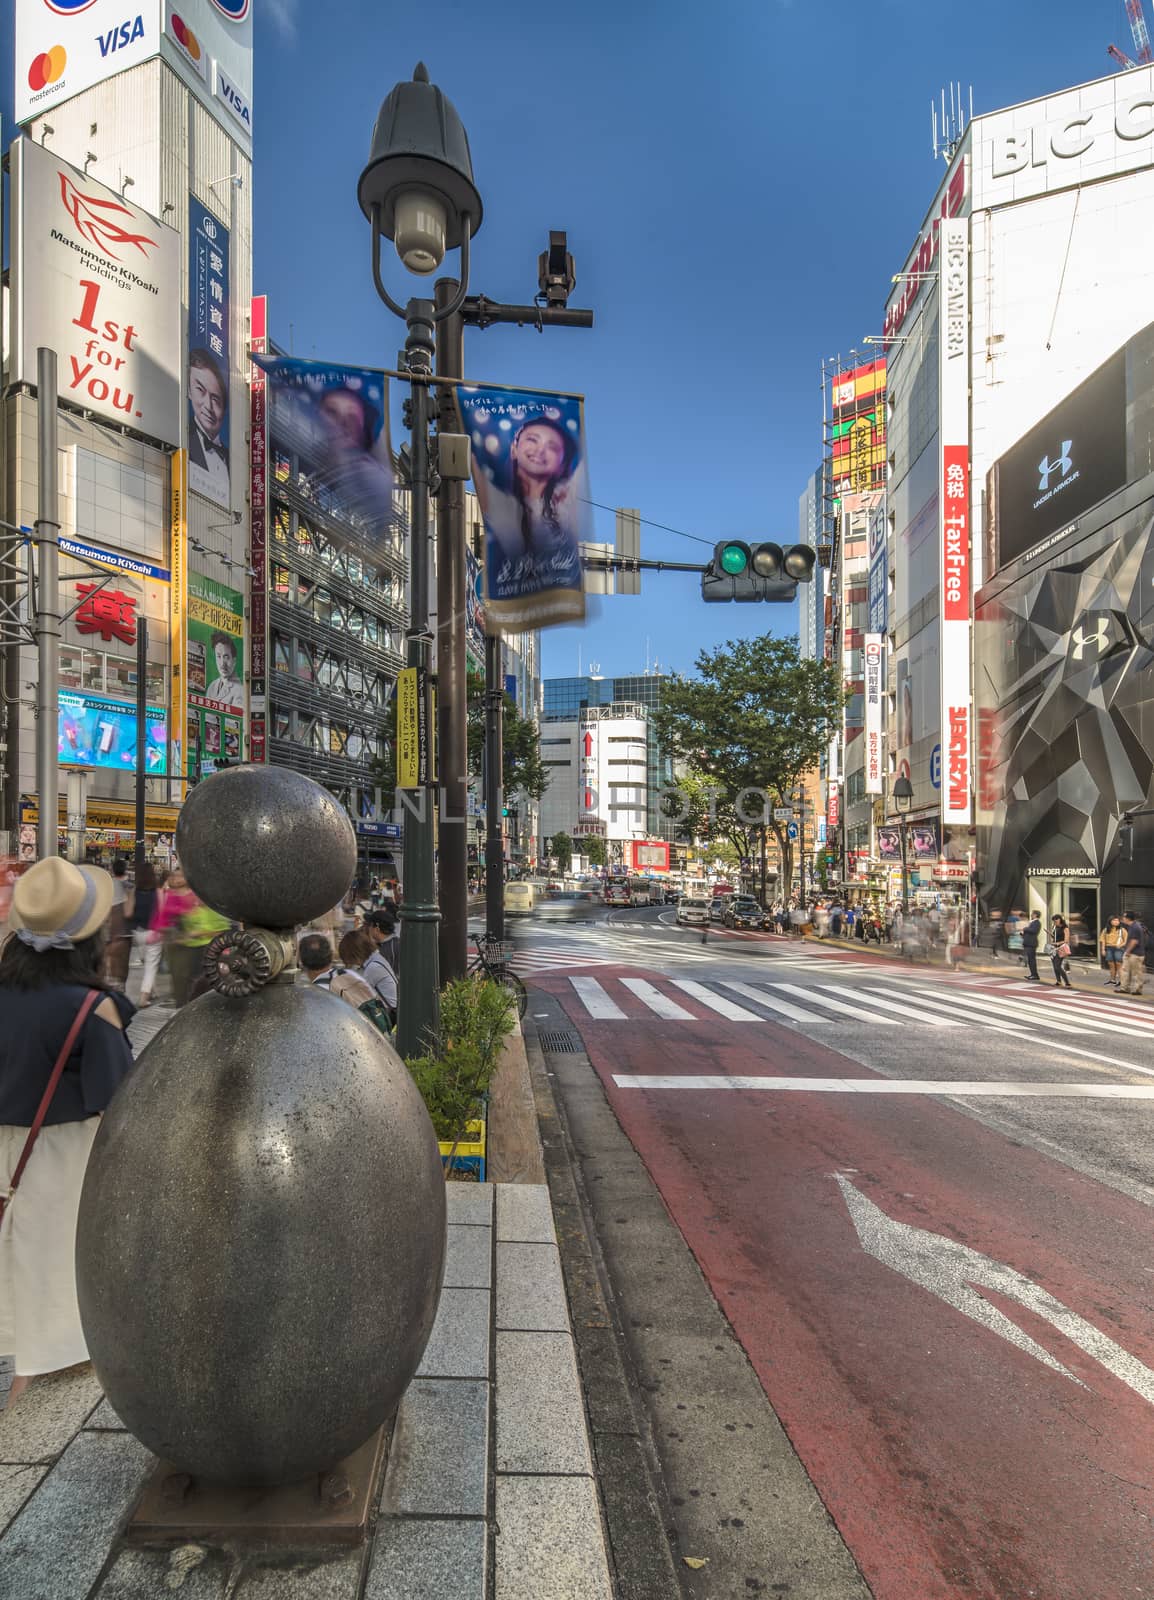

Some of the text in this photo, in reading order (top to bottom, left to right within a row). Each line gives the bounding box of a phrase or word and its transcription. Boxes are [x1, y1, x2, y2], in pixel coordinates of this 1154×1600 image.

[95, 15, 145, 57] VISA
[29, 80, 66, 104] mastercard
[219, 76, 250, 125] VISA
[991, 110, 1095, 180] BIC
[50, 229, 117, 274] Matsumoto
[118, 266, 159, 296] KiYoshi
[80, 257, 132, 292] Holdings
[72, 279, 138, 352] 1st
[948, 231, 964, 360] BIC CAMERA
[85, 340, 126, 372] for
[1033, 470, 1081, 509] UNDER ARMOUR
[946, 463, 965, 602] 免税 TaxFree
[1032, 524, 1076, 557] UNDER ARMOUR
[60, 540, 152, 576] Matsumoto KiYoshi
[75, 581, 137, 646] 薬
[1036, 868, 1096, 876] UNDER ARMOUR
